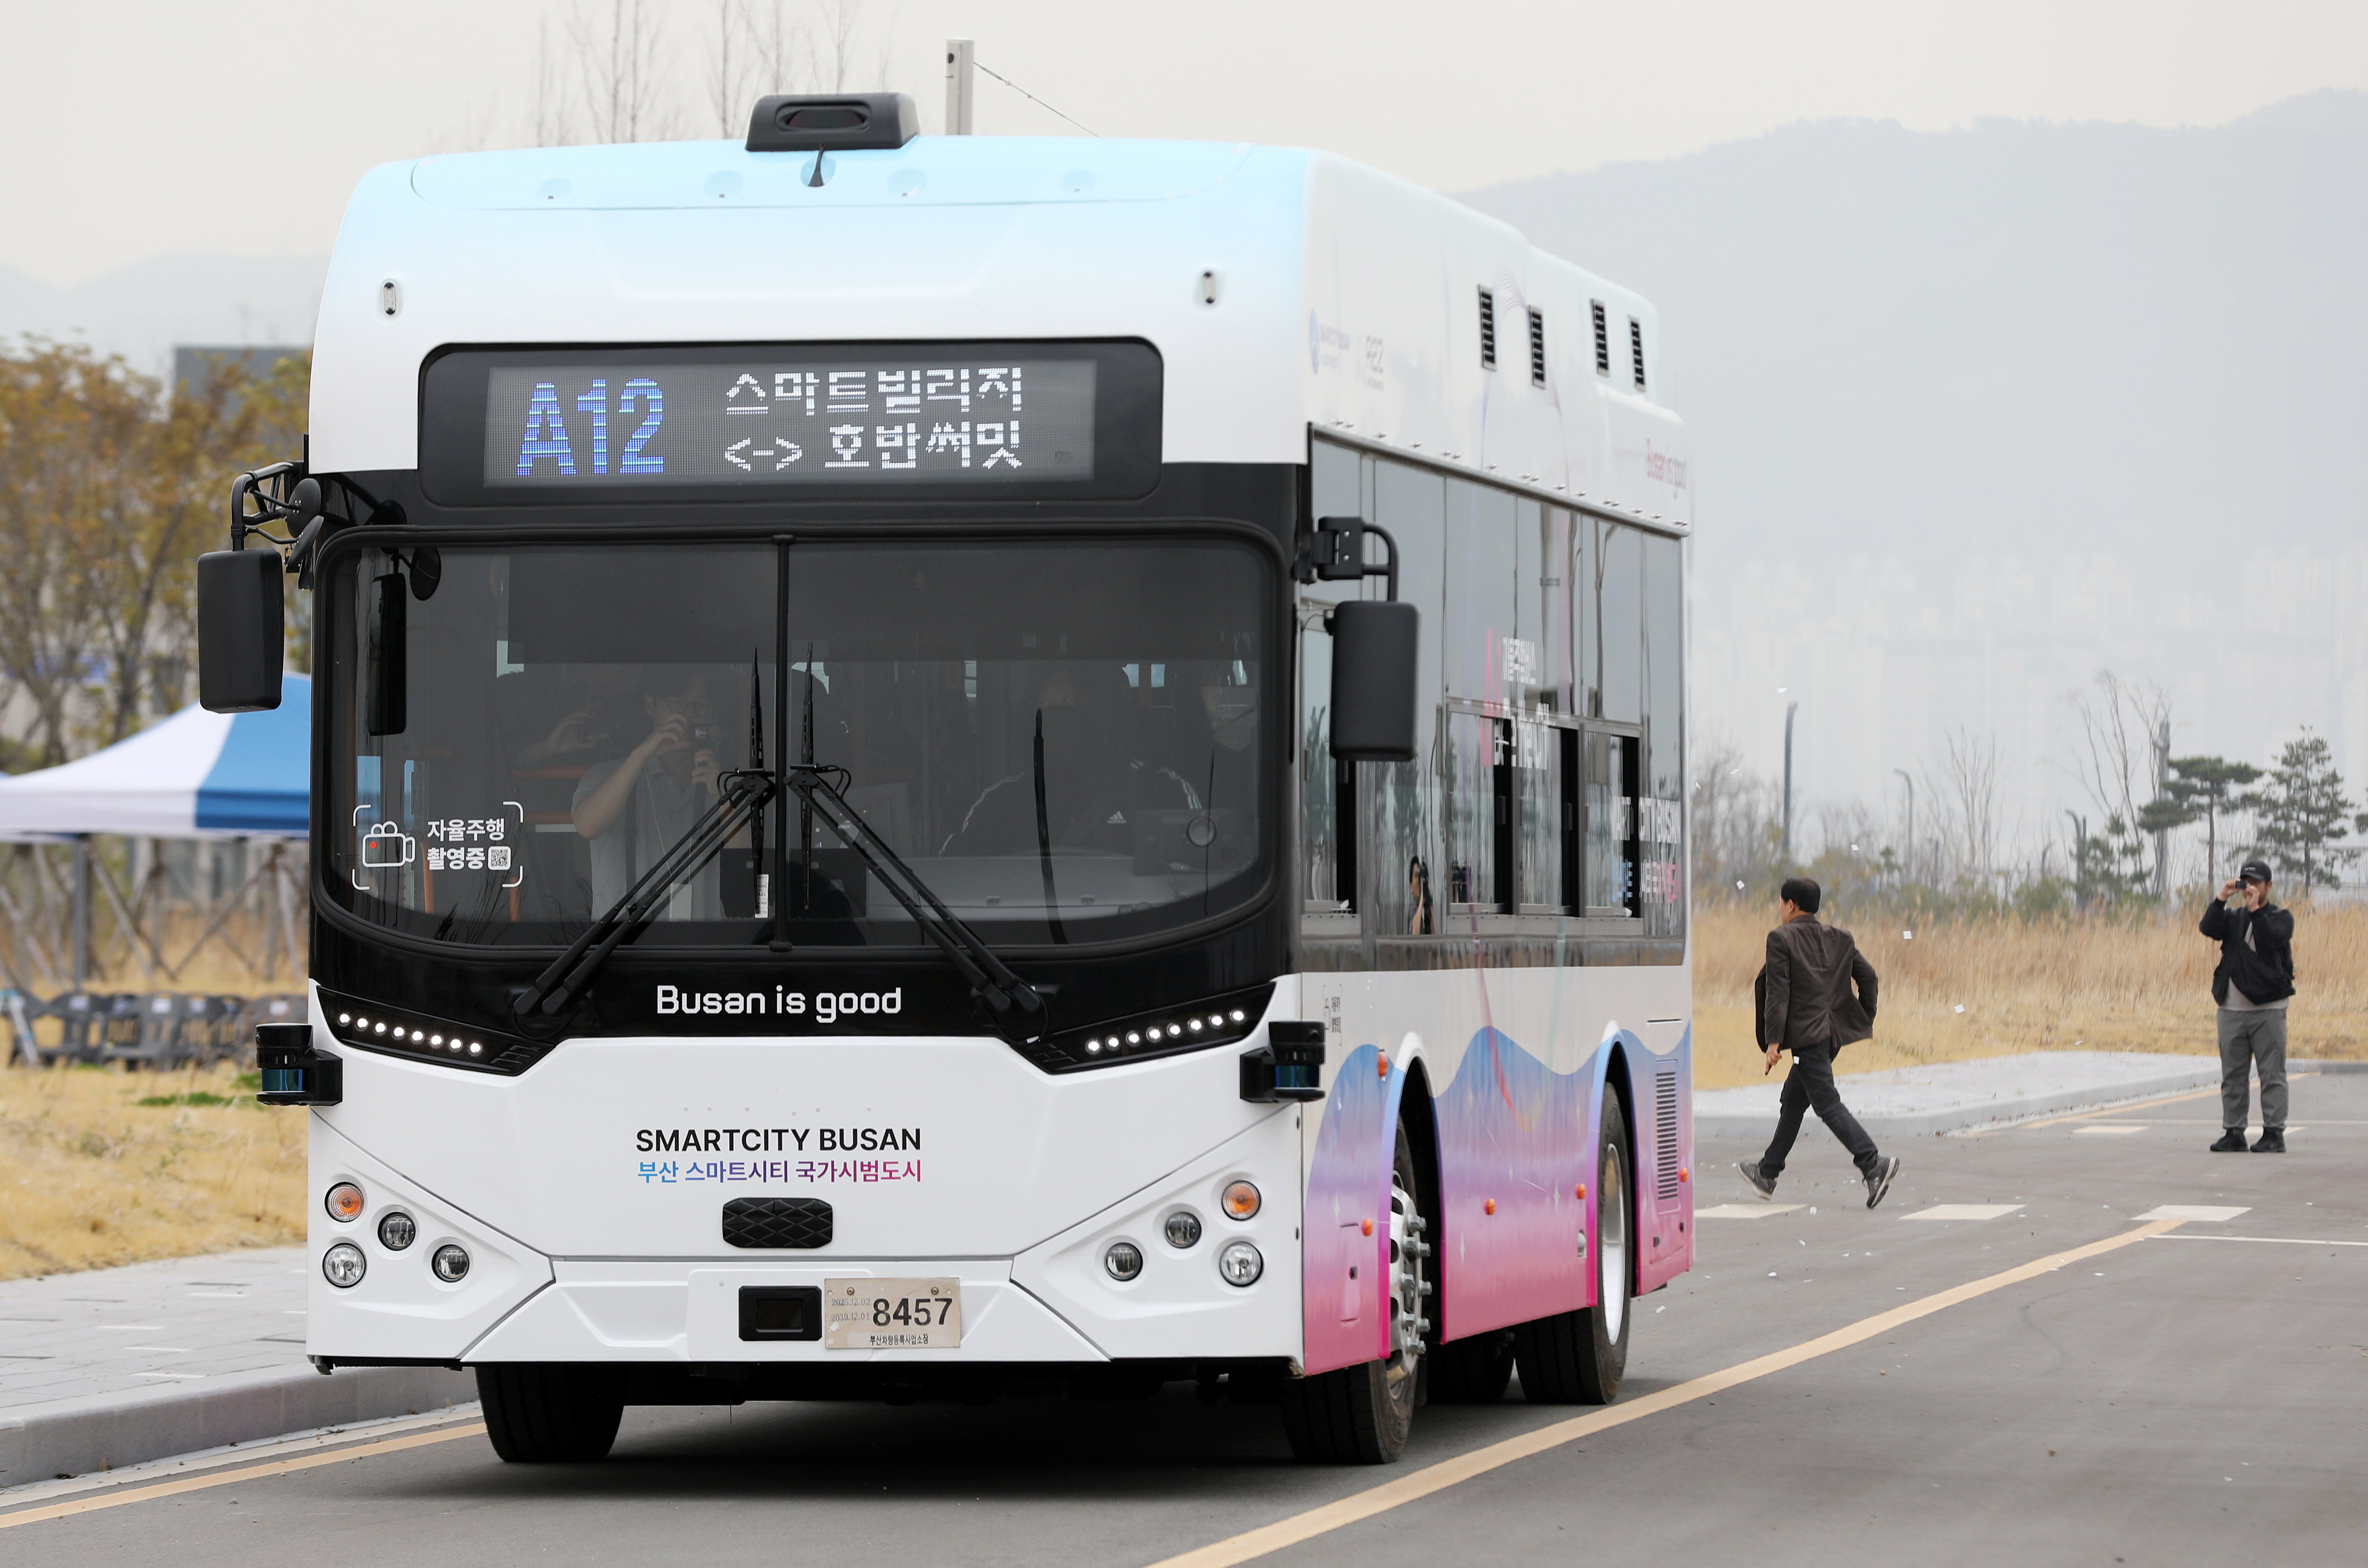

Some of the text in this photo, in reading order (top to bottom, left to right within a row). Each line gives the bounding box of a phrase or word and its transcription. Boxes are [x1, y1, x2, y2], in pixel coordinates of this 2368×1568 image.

[726, 366, 1022, 416] 스마트빌리지
[516, 378, 665, 476] A12
[824, 420, 1023, 470] 호반써밋
[427, 818, 504, 842] 자율주행
[427, 847, 486, 871] 촬영중
[657, 985, 902, 1023] Busan is good
[636, 1128, 921, 1152] SMARTCITY BUSAN
[637, 1159, 921, 1183] 부산 스마트시티 국가시범도시
[831, 1298, 871, 1307] 2025.12.02
[872, 1297, 953, 1327] 8457
[870, 1333, 929, 1346] 부산차량등록사업소장
